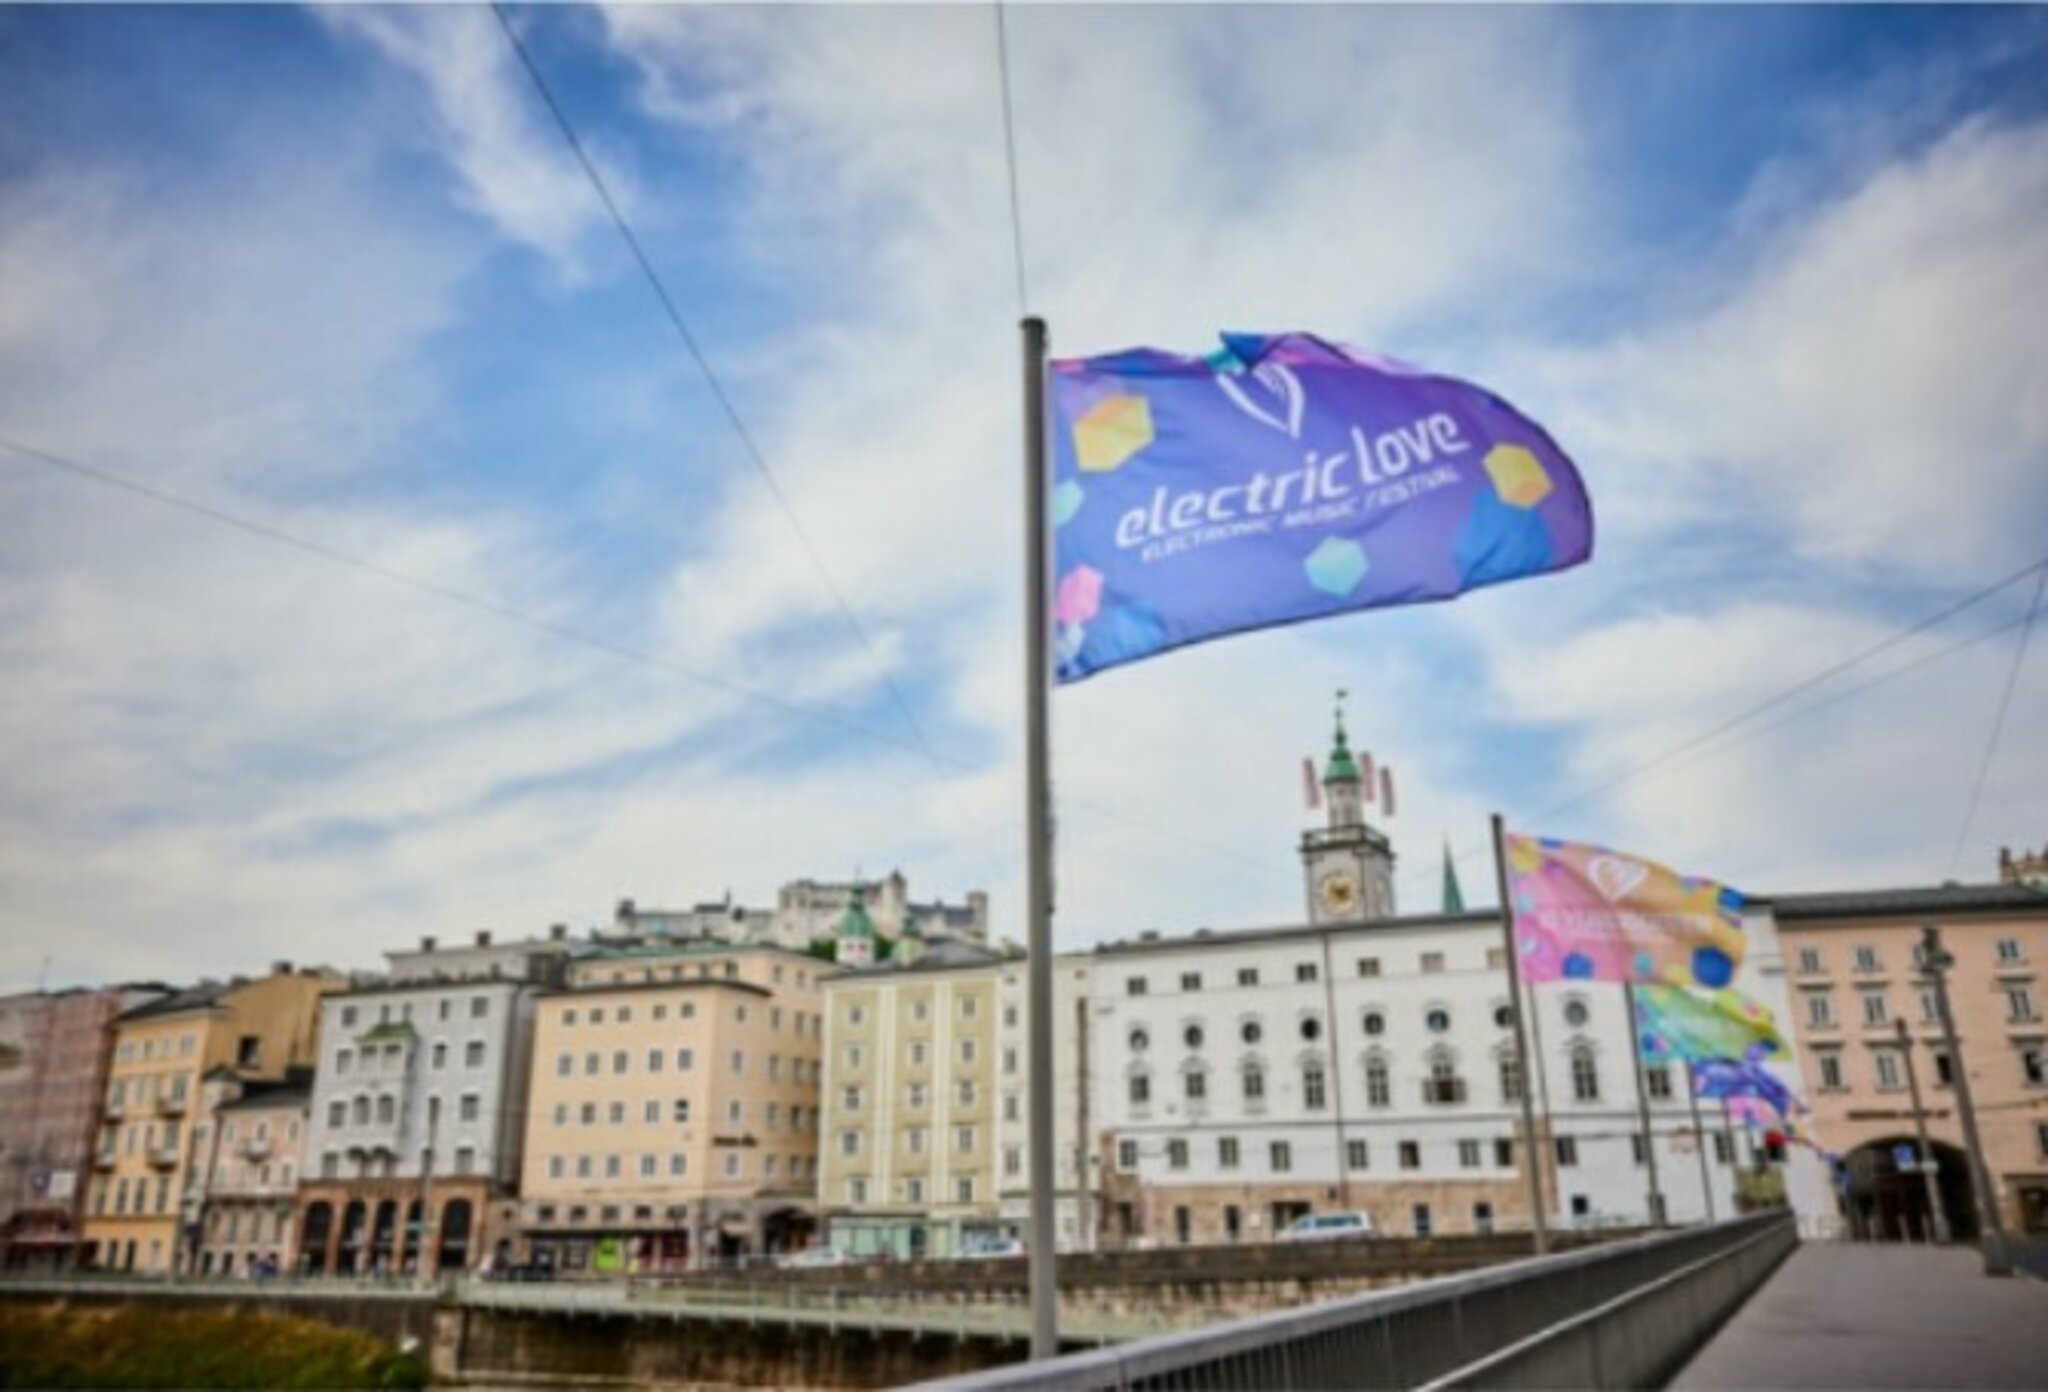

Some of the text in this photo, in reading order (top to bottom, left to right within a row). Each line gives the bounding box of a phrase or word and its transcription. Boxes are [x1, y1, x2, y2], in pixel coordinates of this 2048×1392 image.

[1115, 451, 1351, 548] electric
[1141, 465, 1462, 563] ELECTRONIC MUSIC FESTIVAL
